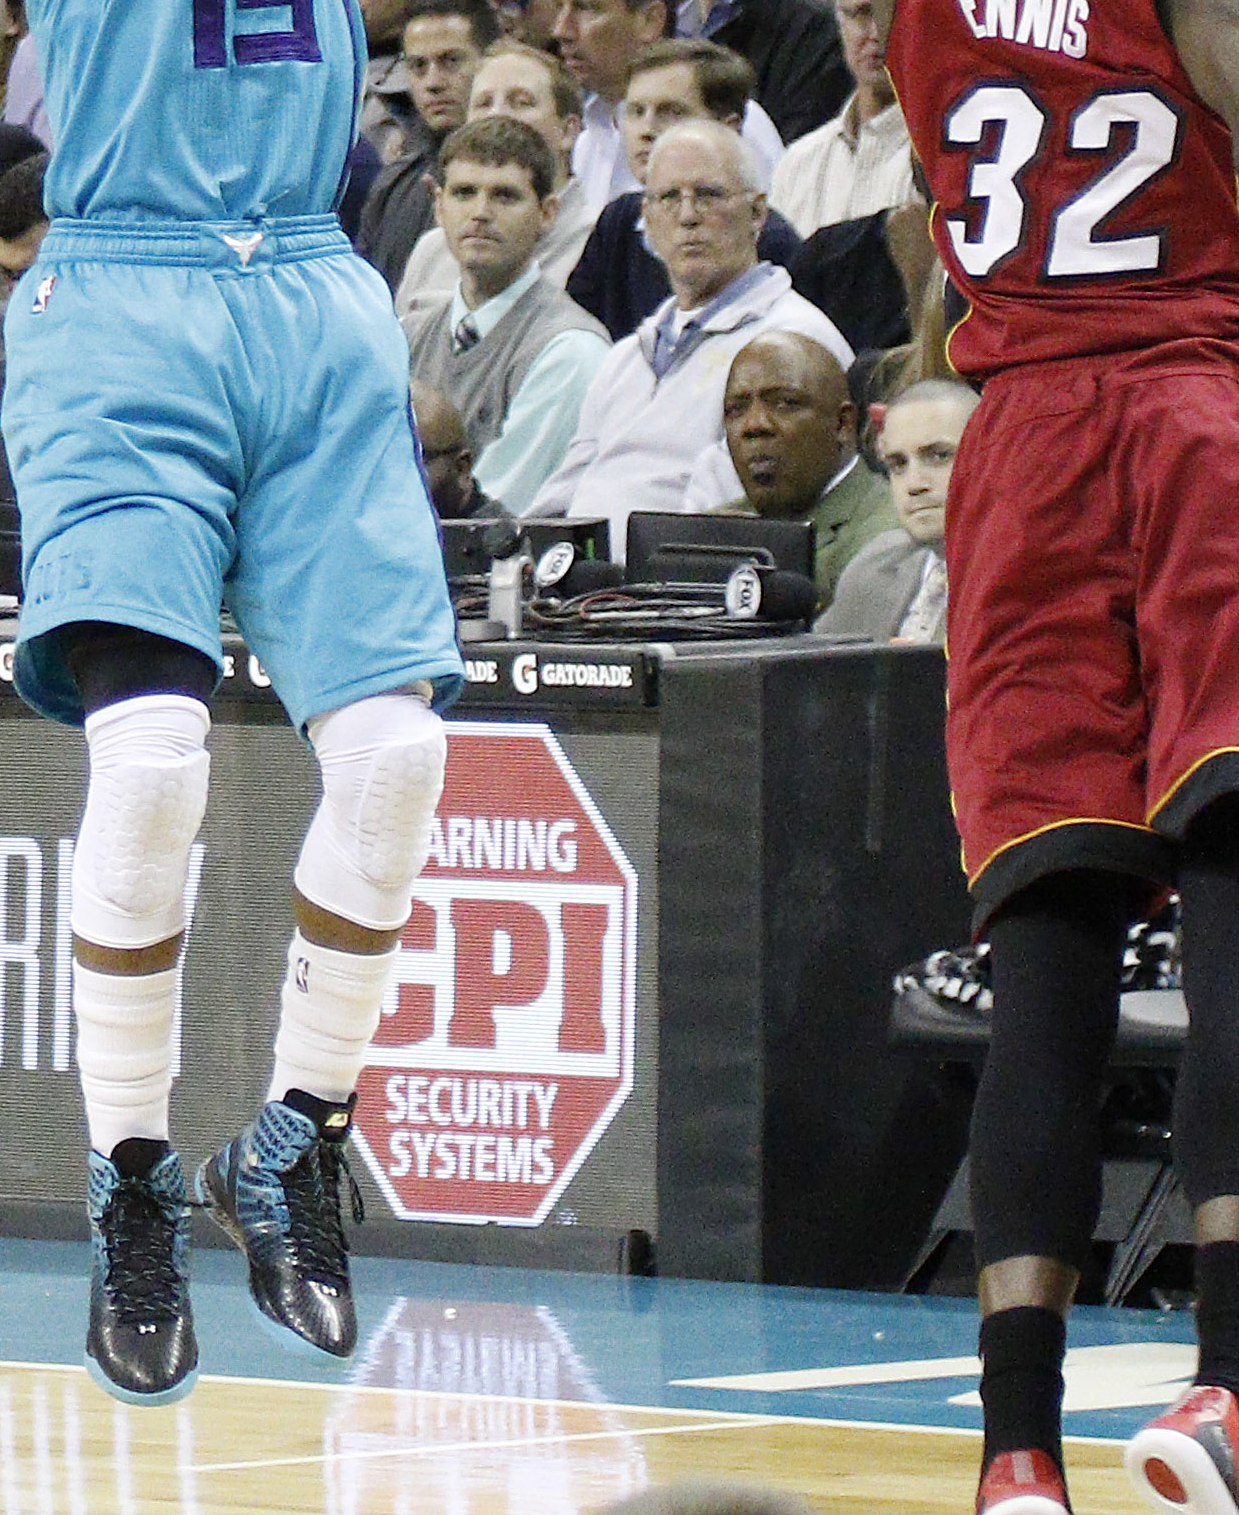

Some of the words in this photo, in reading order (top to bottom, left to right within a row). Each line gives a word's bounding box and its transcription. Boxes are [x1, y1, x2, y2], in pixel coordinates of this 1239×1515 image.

[944, 84, 1181, 279] 32
[512, 653, 537, 695] G
[541, 662, 633, 687] GATORADE
[428, 815, 578, 873] ARNING
[385, 1075, 558, 1129] SECURITY
[389, 1129, 555, 1184] SYSTEMS
